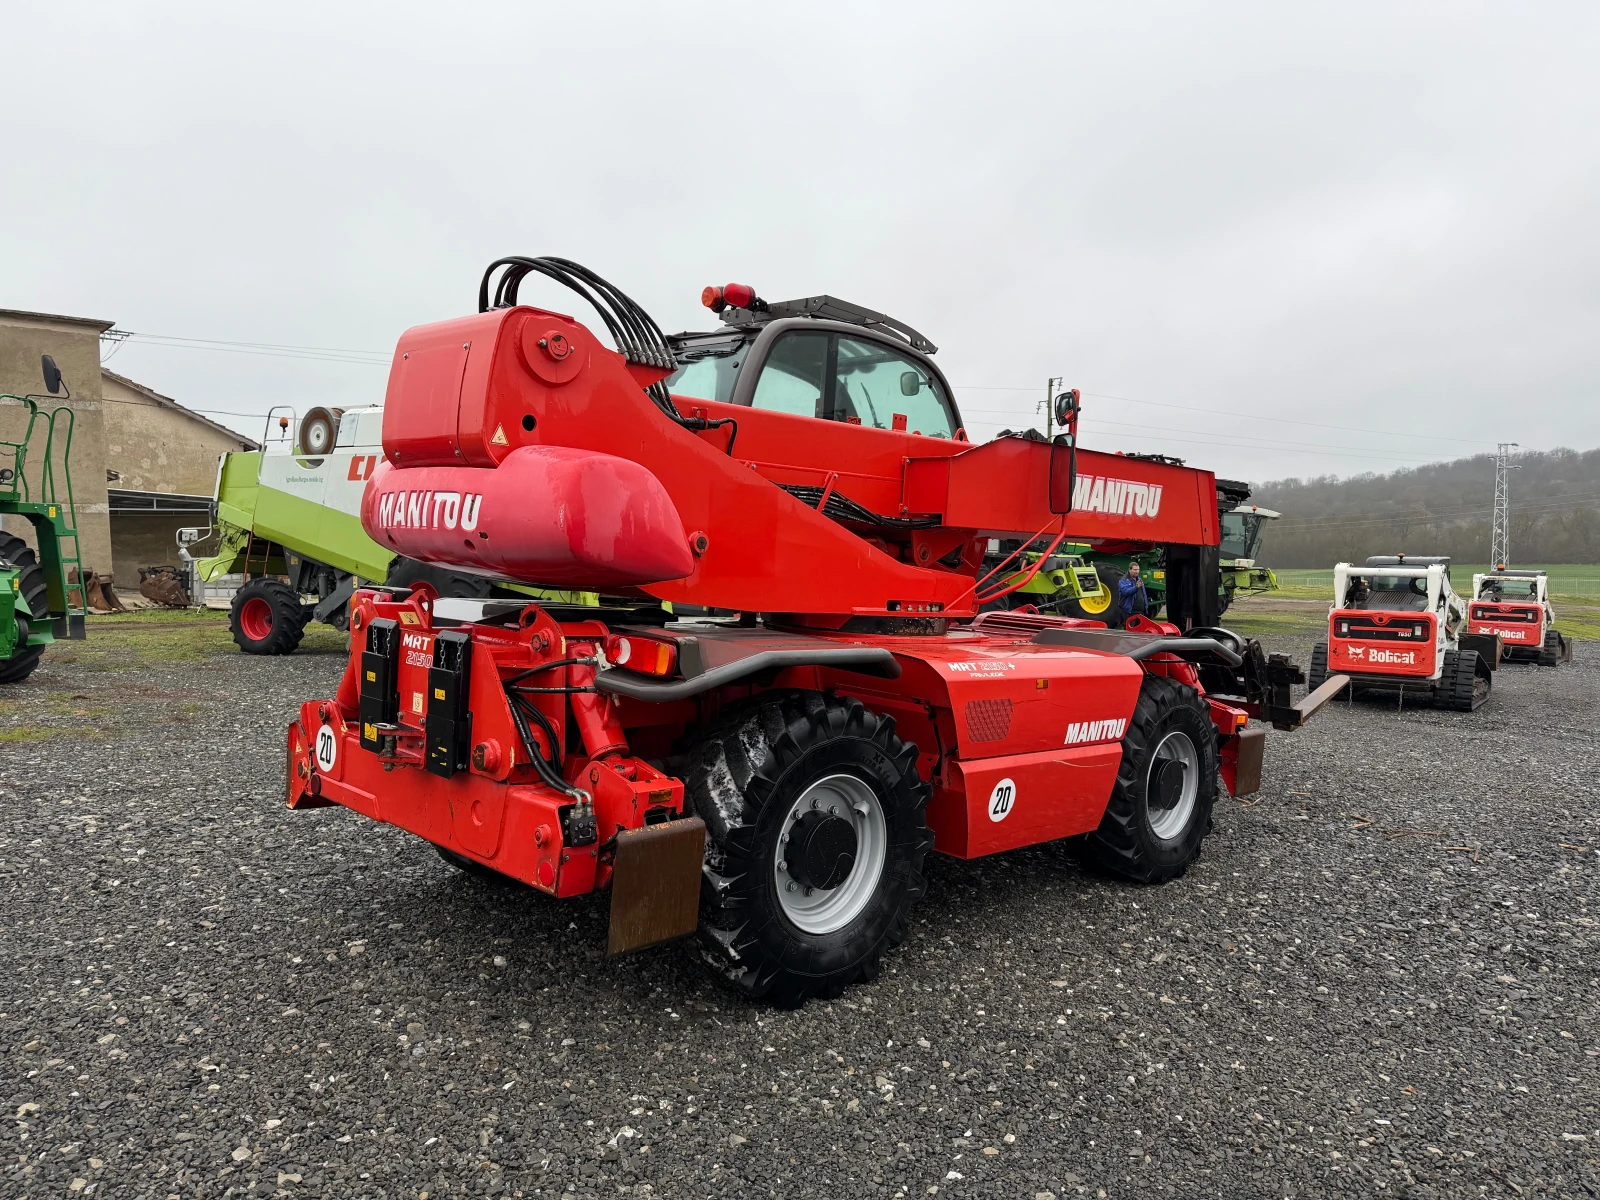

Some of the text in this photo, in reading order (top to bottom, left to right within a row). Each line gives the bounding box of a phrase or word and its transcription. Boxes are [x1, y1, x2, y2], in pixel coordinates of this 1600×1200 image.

[1072, 473, 1163, 517] MANITOU
[380, 490, 483, 531] MANITOU
[402, 633, 431, 651] MRT
[1493, 628, 1526, 639] Bobcat
[405, 650, 434, 668] 2150
[947, 662, 977, 671] MRT
[1368, 648, 1415, 665] Bobcat
[1064, 718, 1126, 744] MANITOU
[319, 732, 332, 764] 20
[992, 786, 1012, 815] 20
